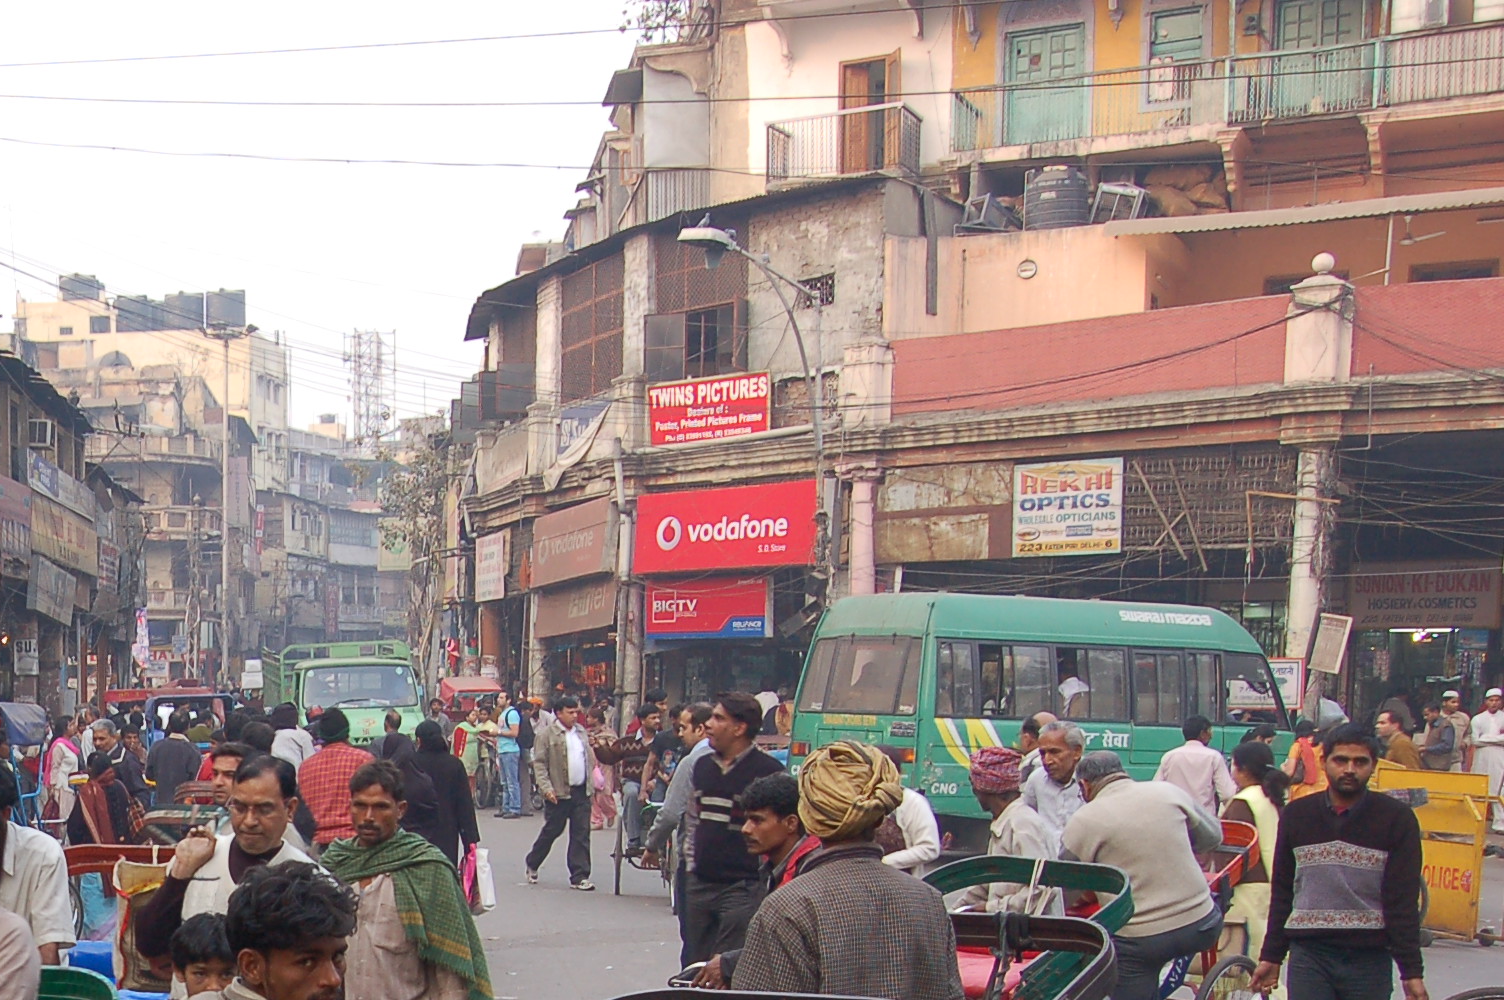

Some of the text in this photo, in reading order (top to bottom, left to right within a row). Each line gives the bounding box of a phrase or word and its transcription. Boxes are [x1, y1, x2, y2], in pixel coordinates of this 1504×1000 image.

[649, 376, 767, 409] TWINS PICTURES
[707, 415, 737, 426] Pictures
[1020, 467, 1113, 495] REKHI
[1019, 493, 1111, 511] OPTICS
[1056, 511, 1116, 524] OPTICIANS
[687, 514, 788, 542] vodafone
[1019, 542, 1043, 552] 223
[1102, 730, 1130, 748] सेवा
[930, 782, 958, 796] CNG
[1422, 864, 1460, 891] OLICE
